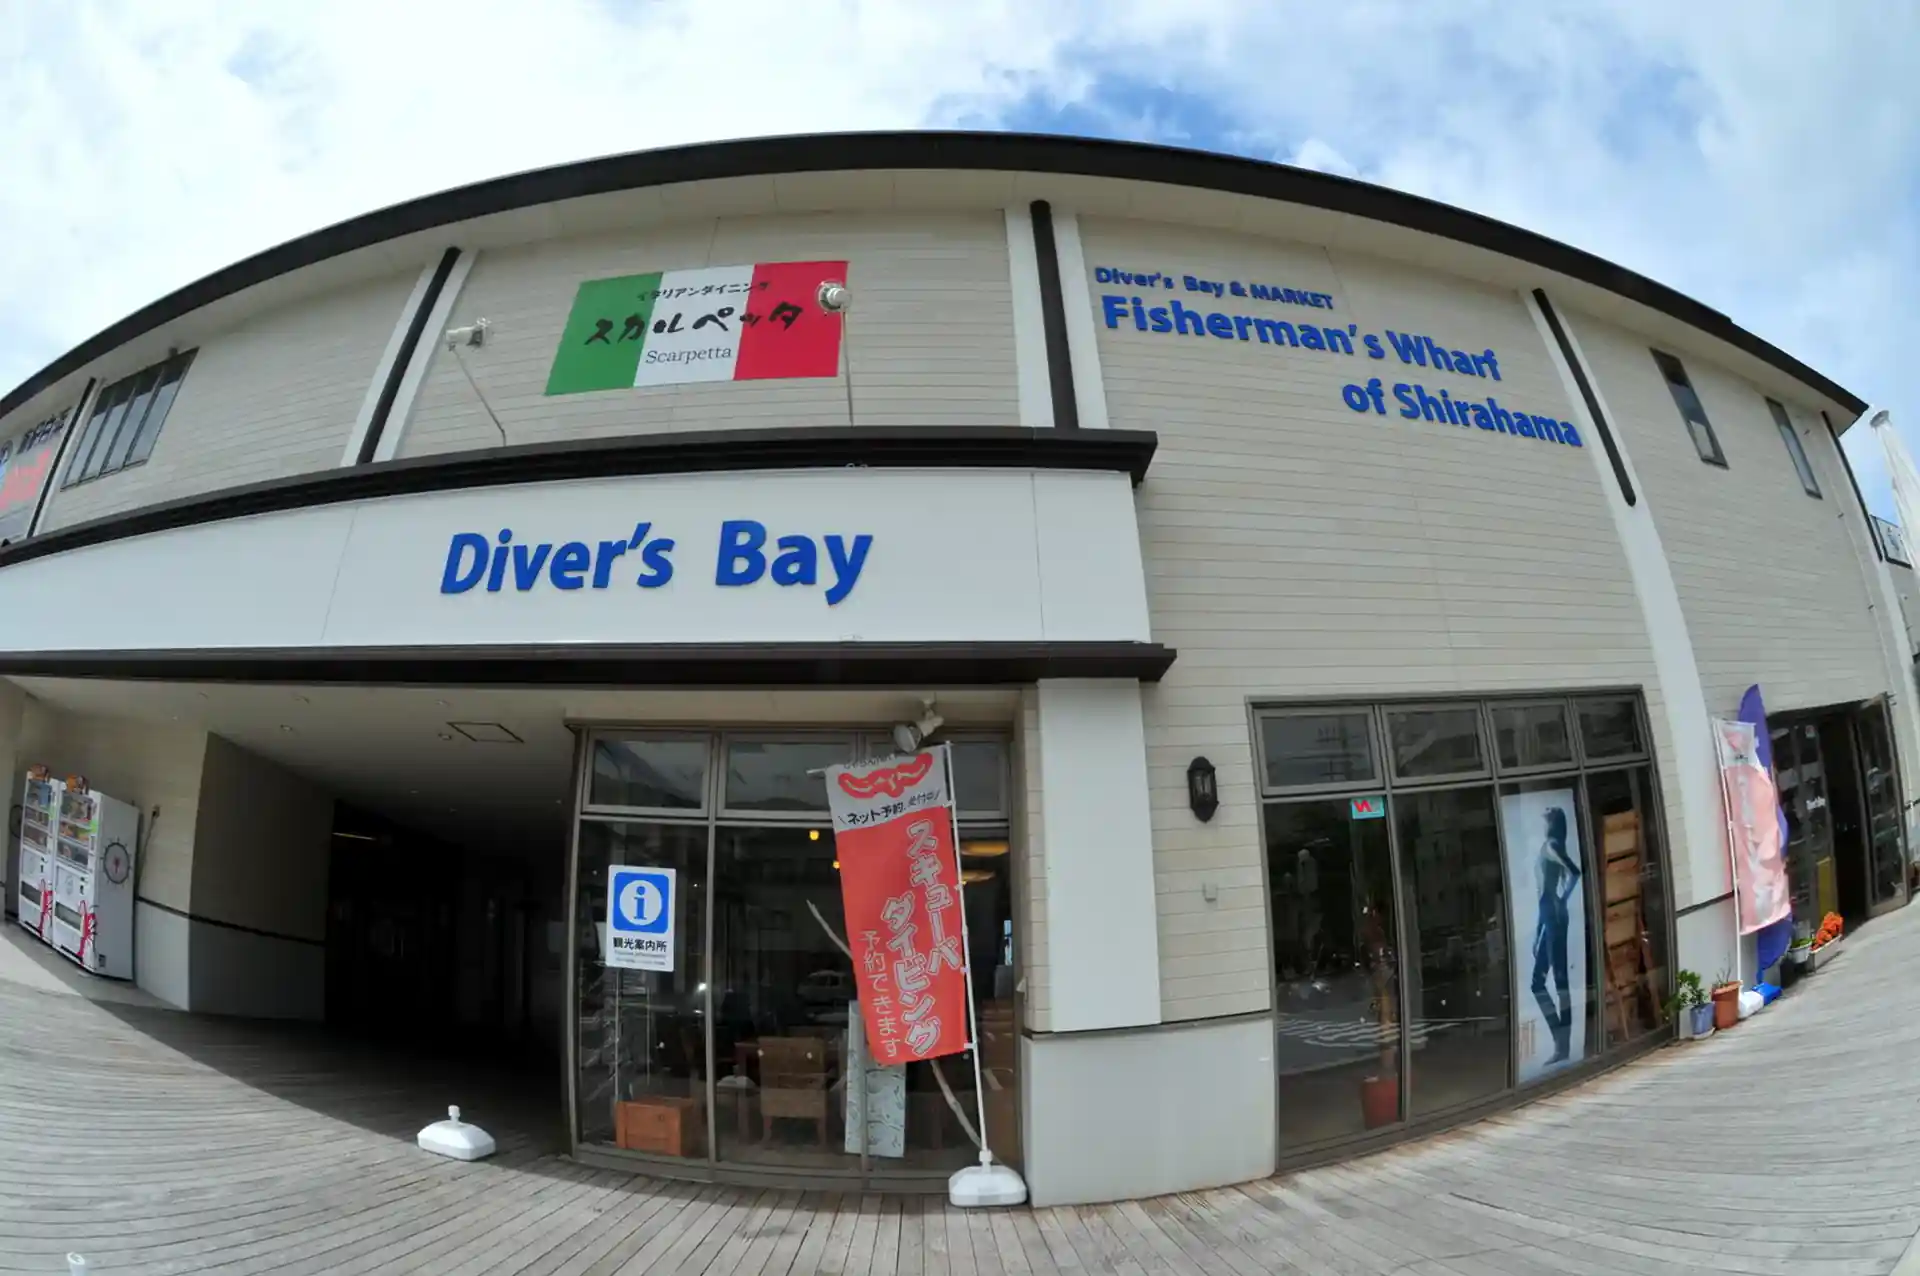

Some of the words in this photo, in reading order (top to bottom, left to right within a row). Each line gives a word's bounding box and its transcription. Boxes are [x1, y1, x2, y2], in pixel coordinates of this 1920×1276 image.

[583, 301, 804, 346] スカルペッタ
[1094, 266, 1174, 290] Diver's
[1183, 275, 1225, 299] Bay
[1230, 281, 1248, 298] &
[1250, 283, 1334, 310] MARKET
[644, 345, 733, 366] Scarpetta
[1101, 294, 1386, 361] Fisherman's
[1385, 329, 1502, 381] Wharf
[1341, 378, 1385, 415] of
[1393, 382, 1583, 448] Shirahama
[440, 522, 675, 595] Diver's
[714, 519, 874, 606] Bay
[905, 819, 961, 976] スキューバ
[859, 929, 901, 1058] 予約できます
[880, 890, 942, 1058] ダイビング
